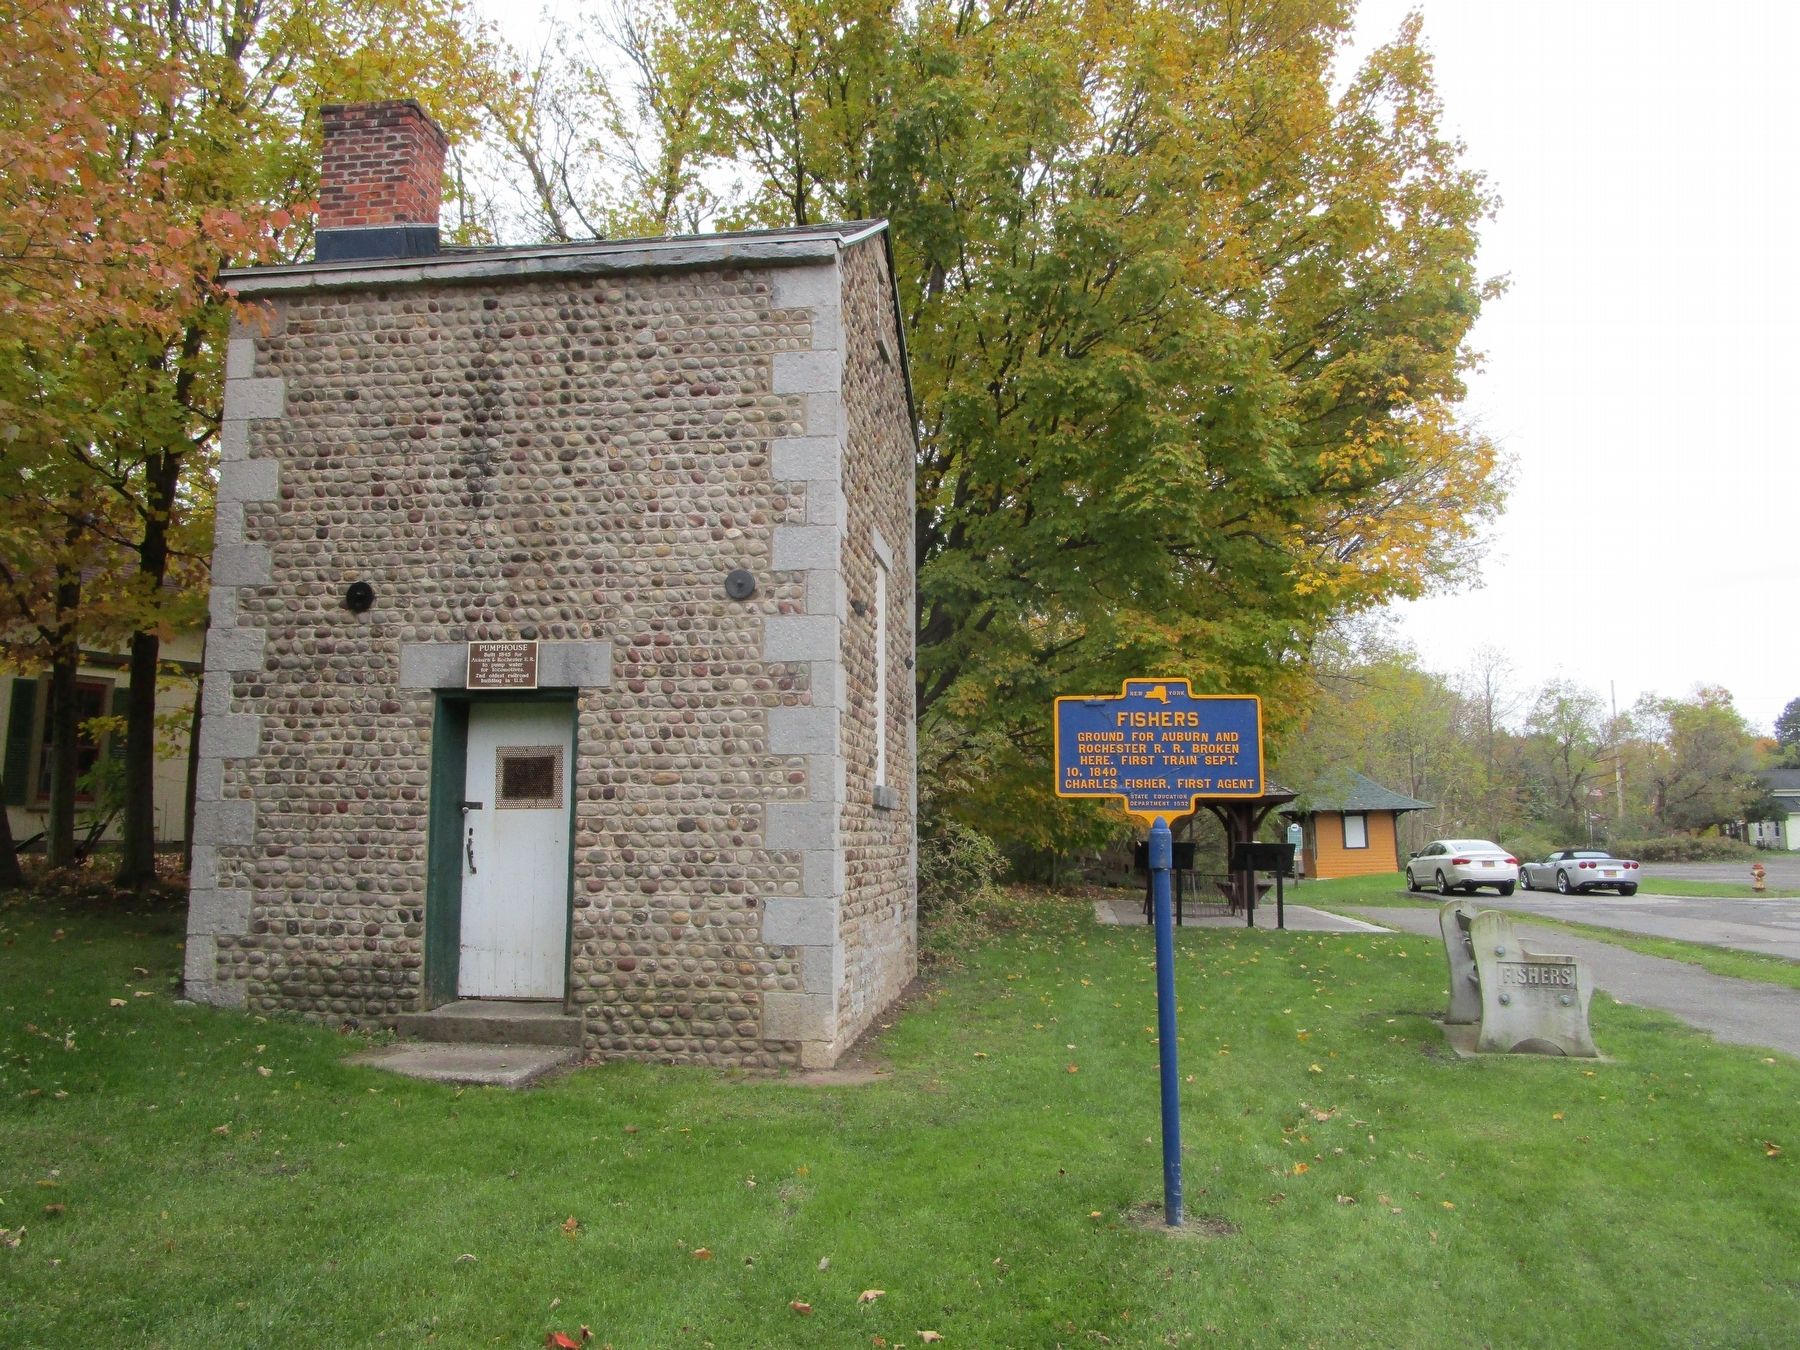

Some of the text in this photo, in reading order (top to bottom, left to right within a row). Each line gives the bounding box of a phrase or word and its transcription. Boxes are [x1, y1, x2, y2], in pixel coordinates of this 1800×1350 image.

[479, 644, 528, 652] PUMPHOUSE
[1116, 711, 1200, 728] FISHERS
[1077, 732, 1239, 743] GROUND FOR AUBURN AND
[1078, 743, 1239, 754] ROCHESTER R. R. BROKEN
[1080, 755, 1238, 765] HERE. FIRST TRAIN SEPT.
[1089, 767, 1117, 777] 1840
[1065, 779, 1118, 789] CHARLES
[1177, 779, 1212, 789] FIRST
[1217, 779, 1255, 789] AGENT
[1502, 965, 1572, 986] FISHERS
